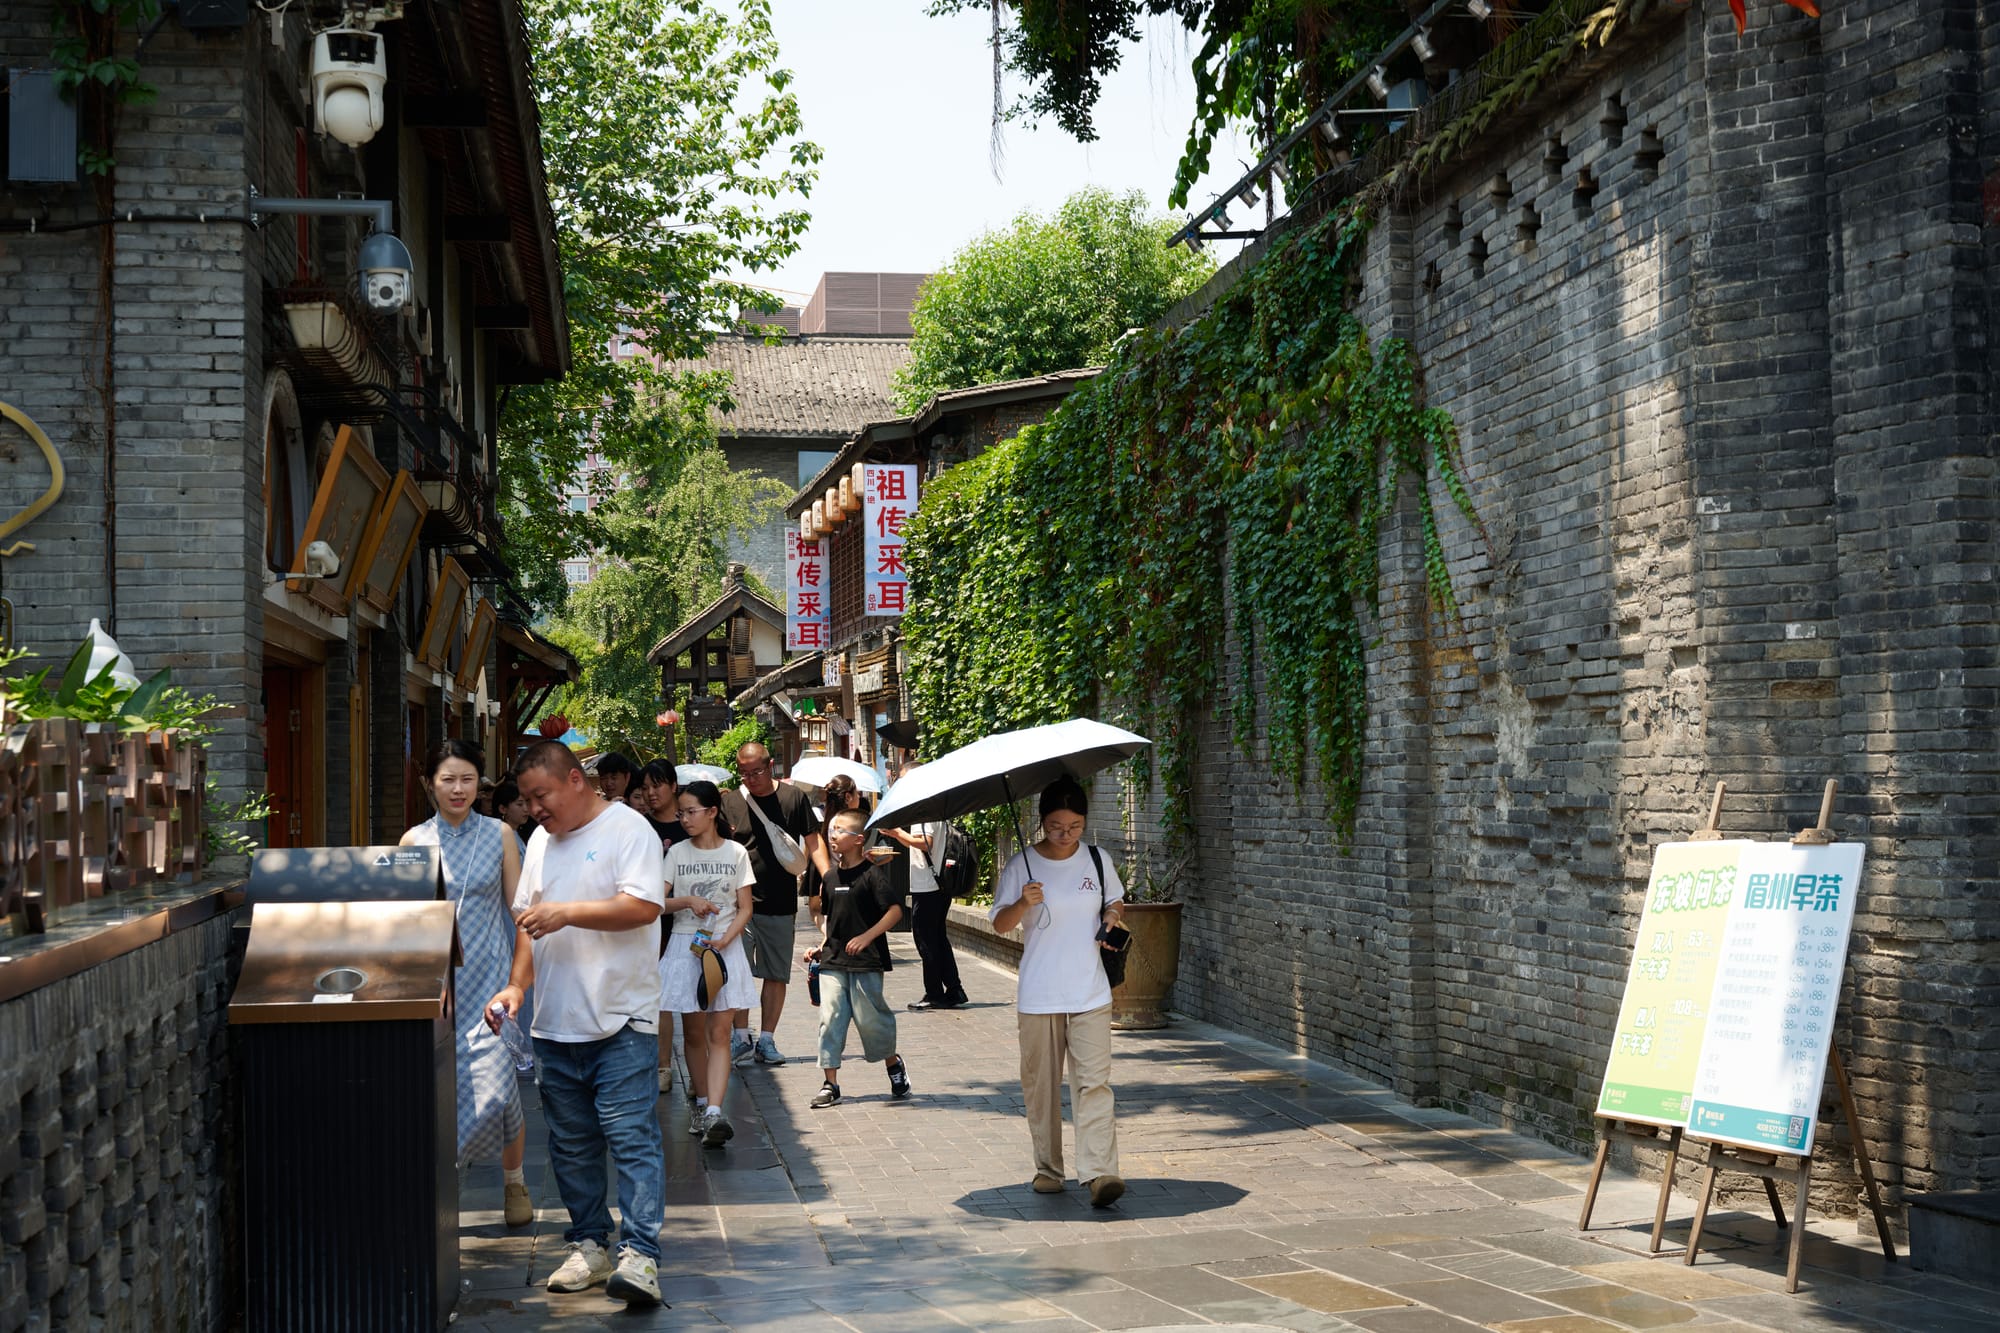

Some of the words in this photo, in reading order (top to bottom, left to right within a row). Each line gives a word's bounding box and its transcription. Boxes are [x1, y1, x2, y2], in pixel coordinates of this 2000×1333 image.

[866, 469, 876, 504] 四川一绝
[876, 469, 909, 613] 祖传采耳
[867, 593, 877, 612] 总店
[677, 863, 738, 876] HOGWARTS
[1651, 865, 1738, 914] 东坡问茶
[1744, 873, 1843, 912] 眉州早茶
[1650, 931, 1675, 954] 双人
[1636, 957, 1672, 981] 下午茶
[1619, 1031, 1654, 1056] 下午茶
